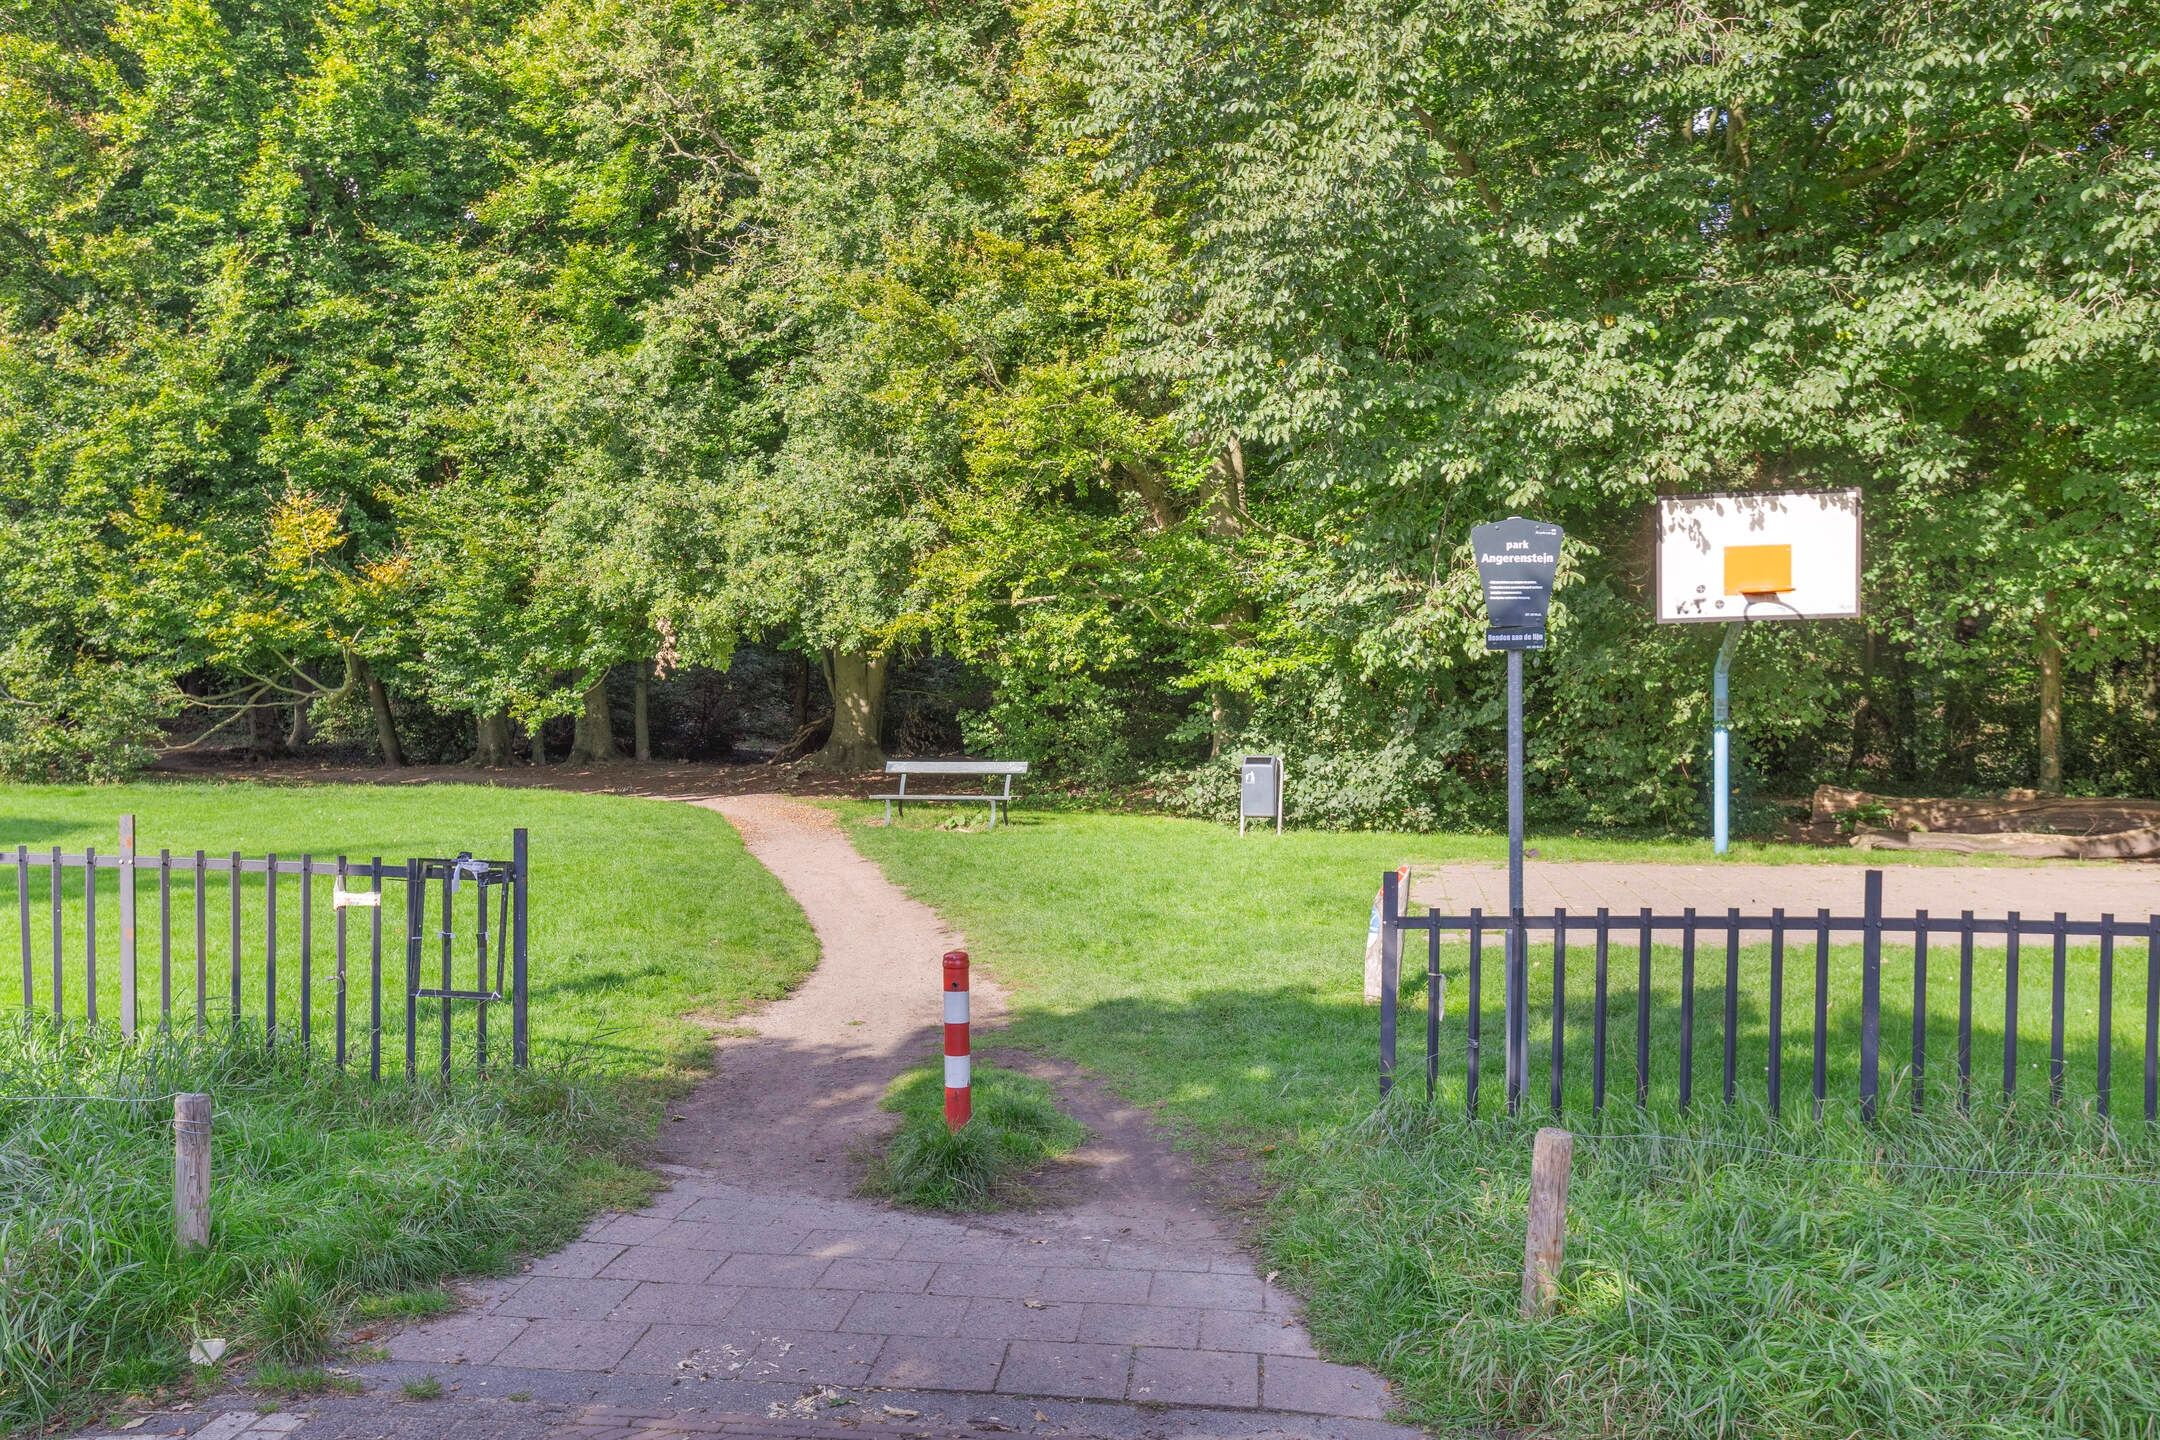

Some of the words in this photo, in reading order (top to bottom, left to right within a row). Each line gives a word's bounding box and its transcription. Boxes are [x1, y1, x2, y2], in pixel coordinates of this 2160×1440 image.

[1506, 540, 1529, 551] park
[1481, 553, 1554, 565] Angerenstein
[1532, 633, 1544, 641] lijn
